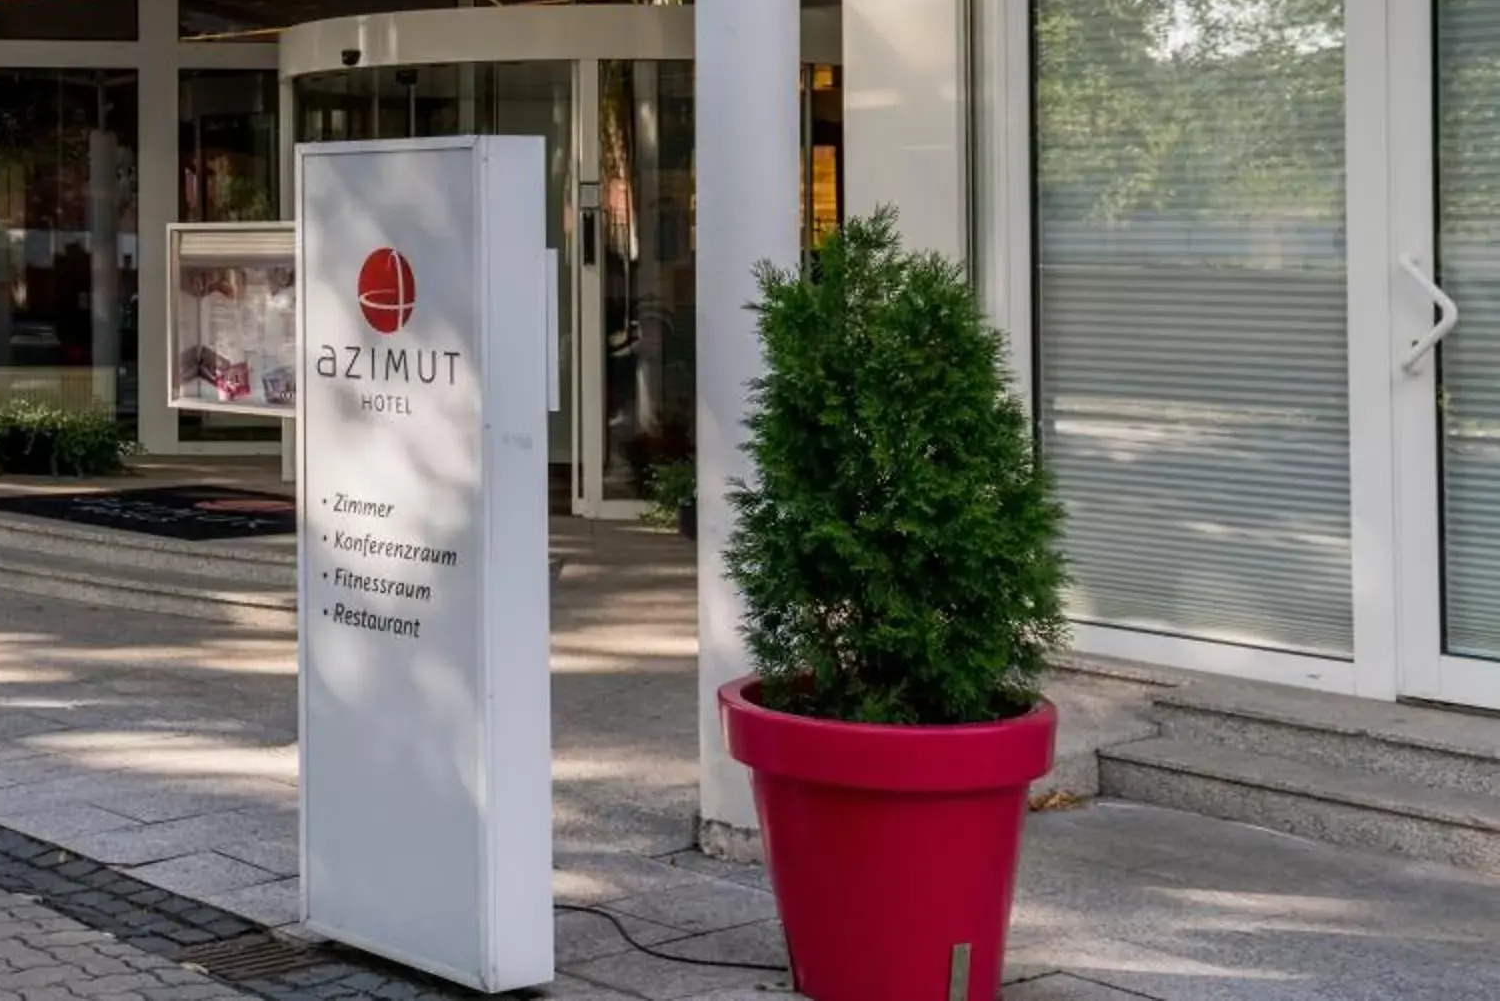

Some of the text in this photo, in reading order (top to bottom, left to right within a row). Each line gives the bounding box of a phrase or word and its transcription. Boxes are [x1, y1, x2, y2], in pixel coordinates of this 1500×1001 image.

[361, 394, 412, 416] HOTEL
[333, 493, 395, 519] Zimmer
[333, 531, 457, 567] Konferenzraum
[333, 567, 431, 601] Fitnessraum
[332, 603, 421, 639] Restaurant
